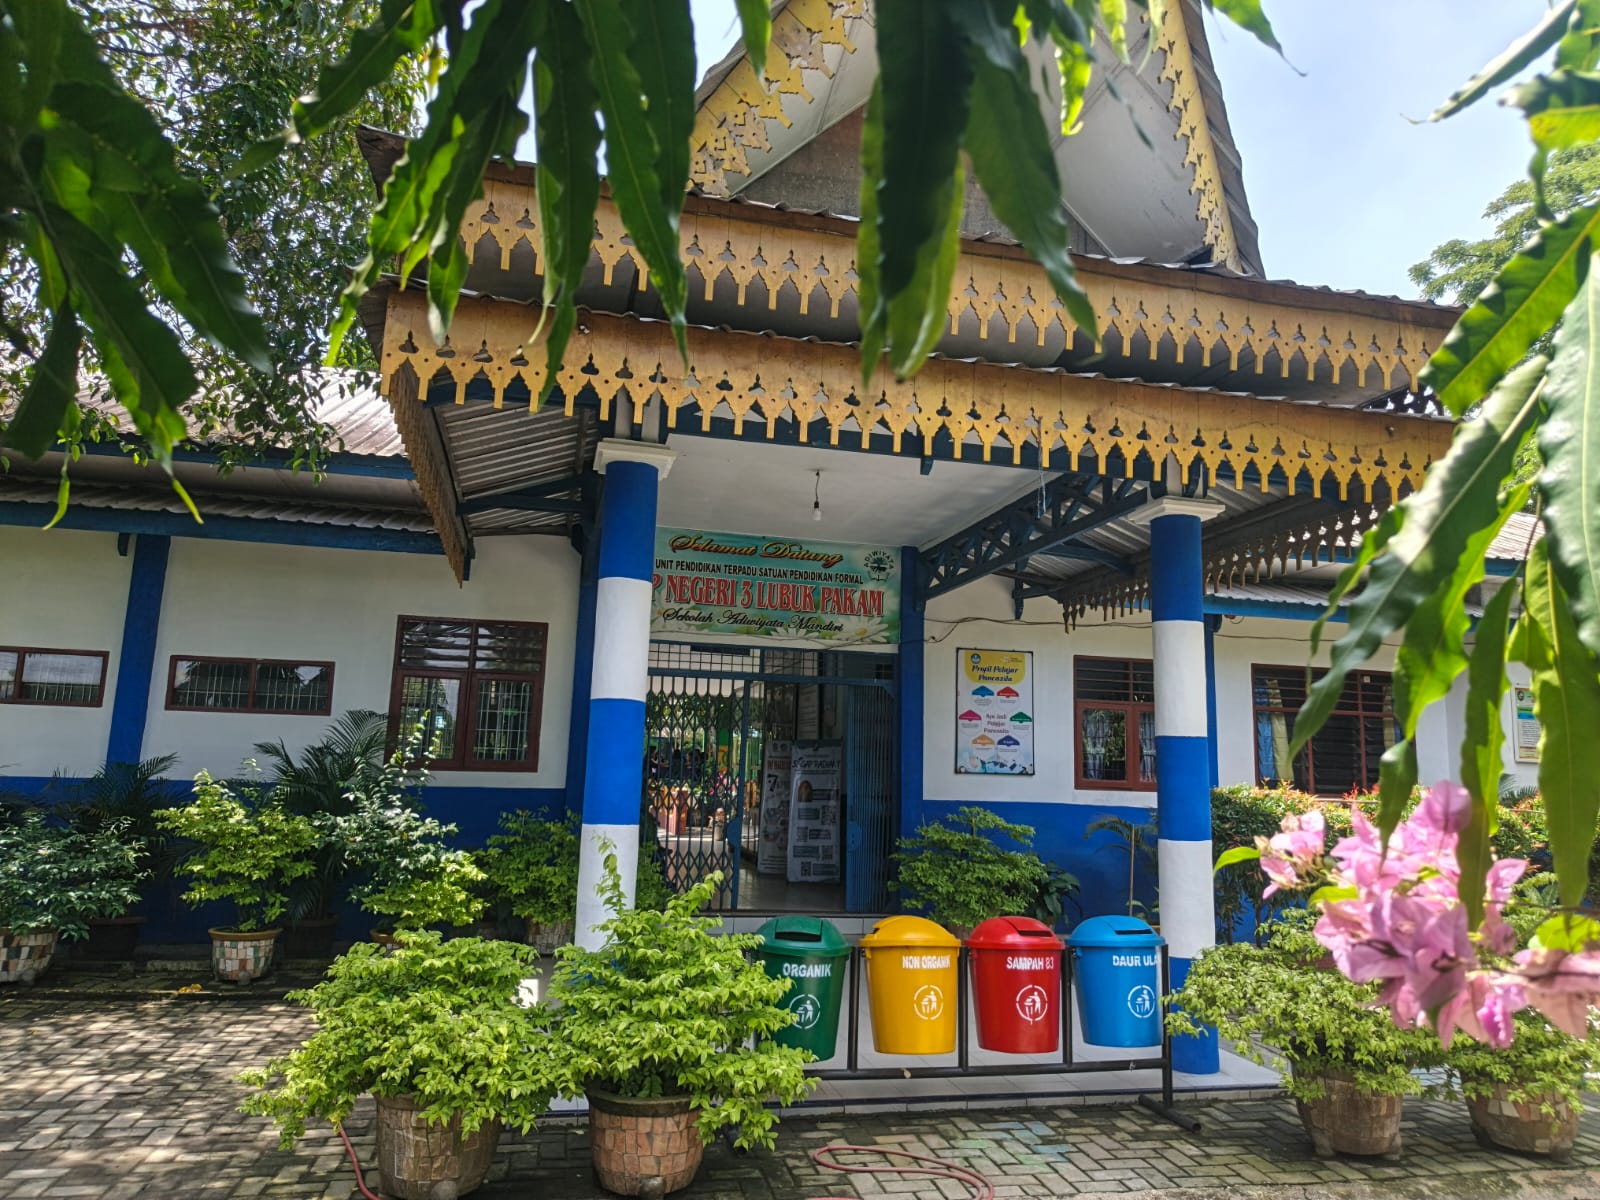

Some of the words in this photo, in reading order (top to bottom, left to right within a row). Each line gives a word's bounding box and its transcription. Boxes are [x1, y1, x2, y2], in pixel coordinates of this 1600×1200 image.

[669, 535, 758, 556] Selamat
[758, 541, 843, 568] Datang
[655, 559, 673, 570] UNIT
[676, 560, 721, 573] PENDIDIKAN
[724, 564, 756, 576] TERPADU
[759, 568, 788, 579] SATUAN
[789, 569, 833, 582] PENDIDIKAN
[835, 573, 863, 584] FORMAL
[665, 574, 737, 607] NEGERI
[740, 580, 752, 609] 3
[756, 581, 816, 612] LUBUK
[820, 586, 884, 617] PAKAM
[662, 607, 713, 623] Sekolah
[717, 610, 784, 630] Adiwiyata
[788, 615, 843, 632] Mandiri
[783, 962, 832, 978] ORGANIK
[902, 955, 920, 969] NON
[1006, 956, 1044, 970] SAMPAH
[1112, 955, 1141, 967] DAUR
